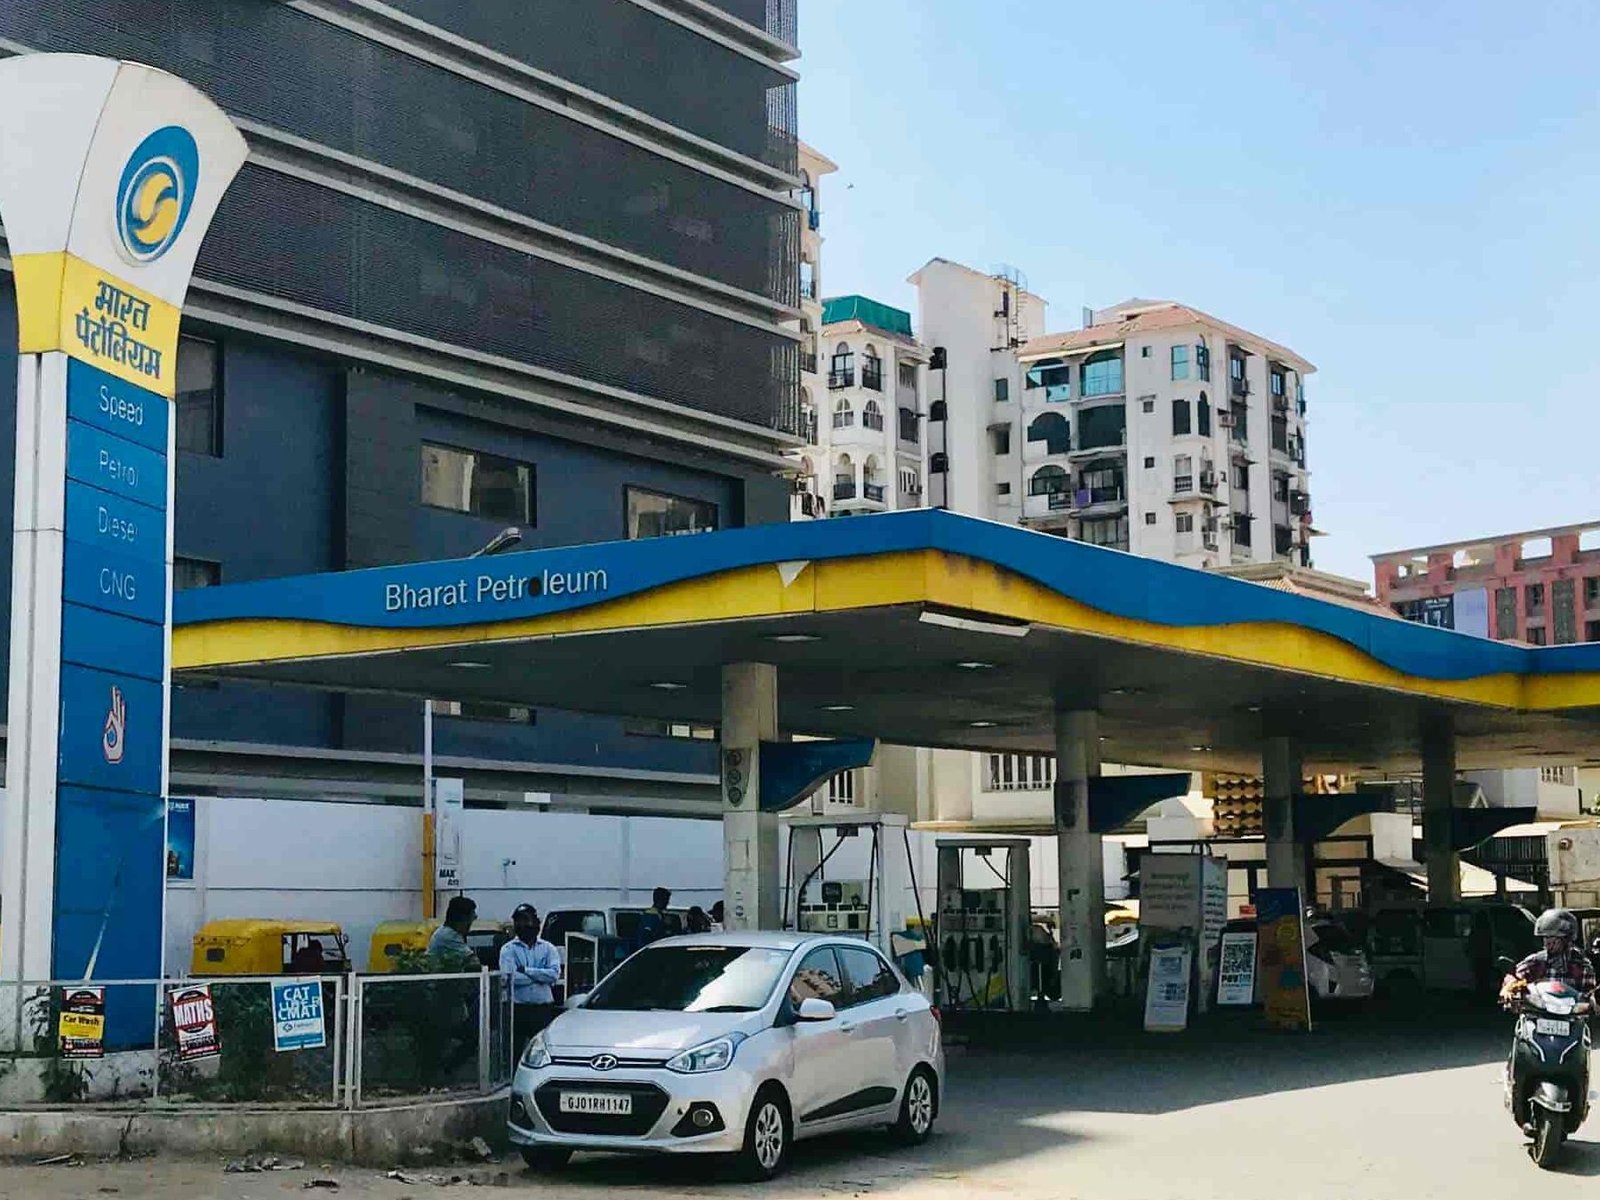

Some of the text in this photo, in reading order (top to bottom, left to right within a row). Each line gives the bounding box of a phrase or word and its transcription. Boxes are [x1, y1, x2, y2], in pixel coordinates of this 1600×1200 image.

[96, 280, 151, 332] भारत
[99, 384, 144, 426] Speed
[100, 567, 136, 600] CNG
[385, 578, 468, 611] Bharat
[283, 986, 310, 1001] CAT
[173, 998, 214, 1027] MATHS
[277, 1004, 318, 1021] CMAT
[567, 1096, 630, 1112] GJ01RH1147
